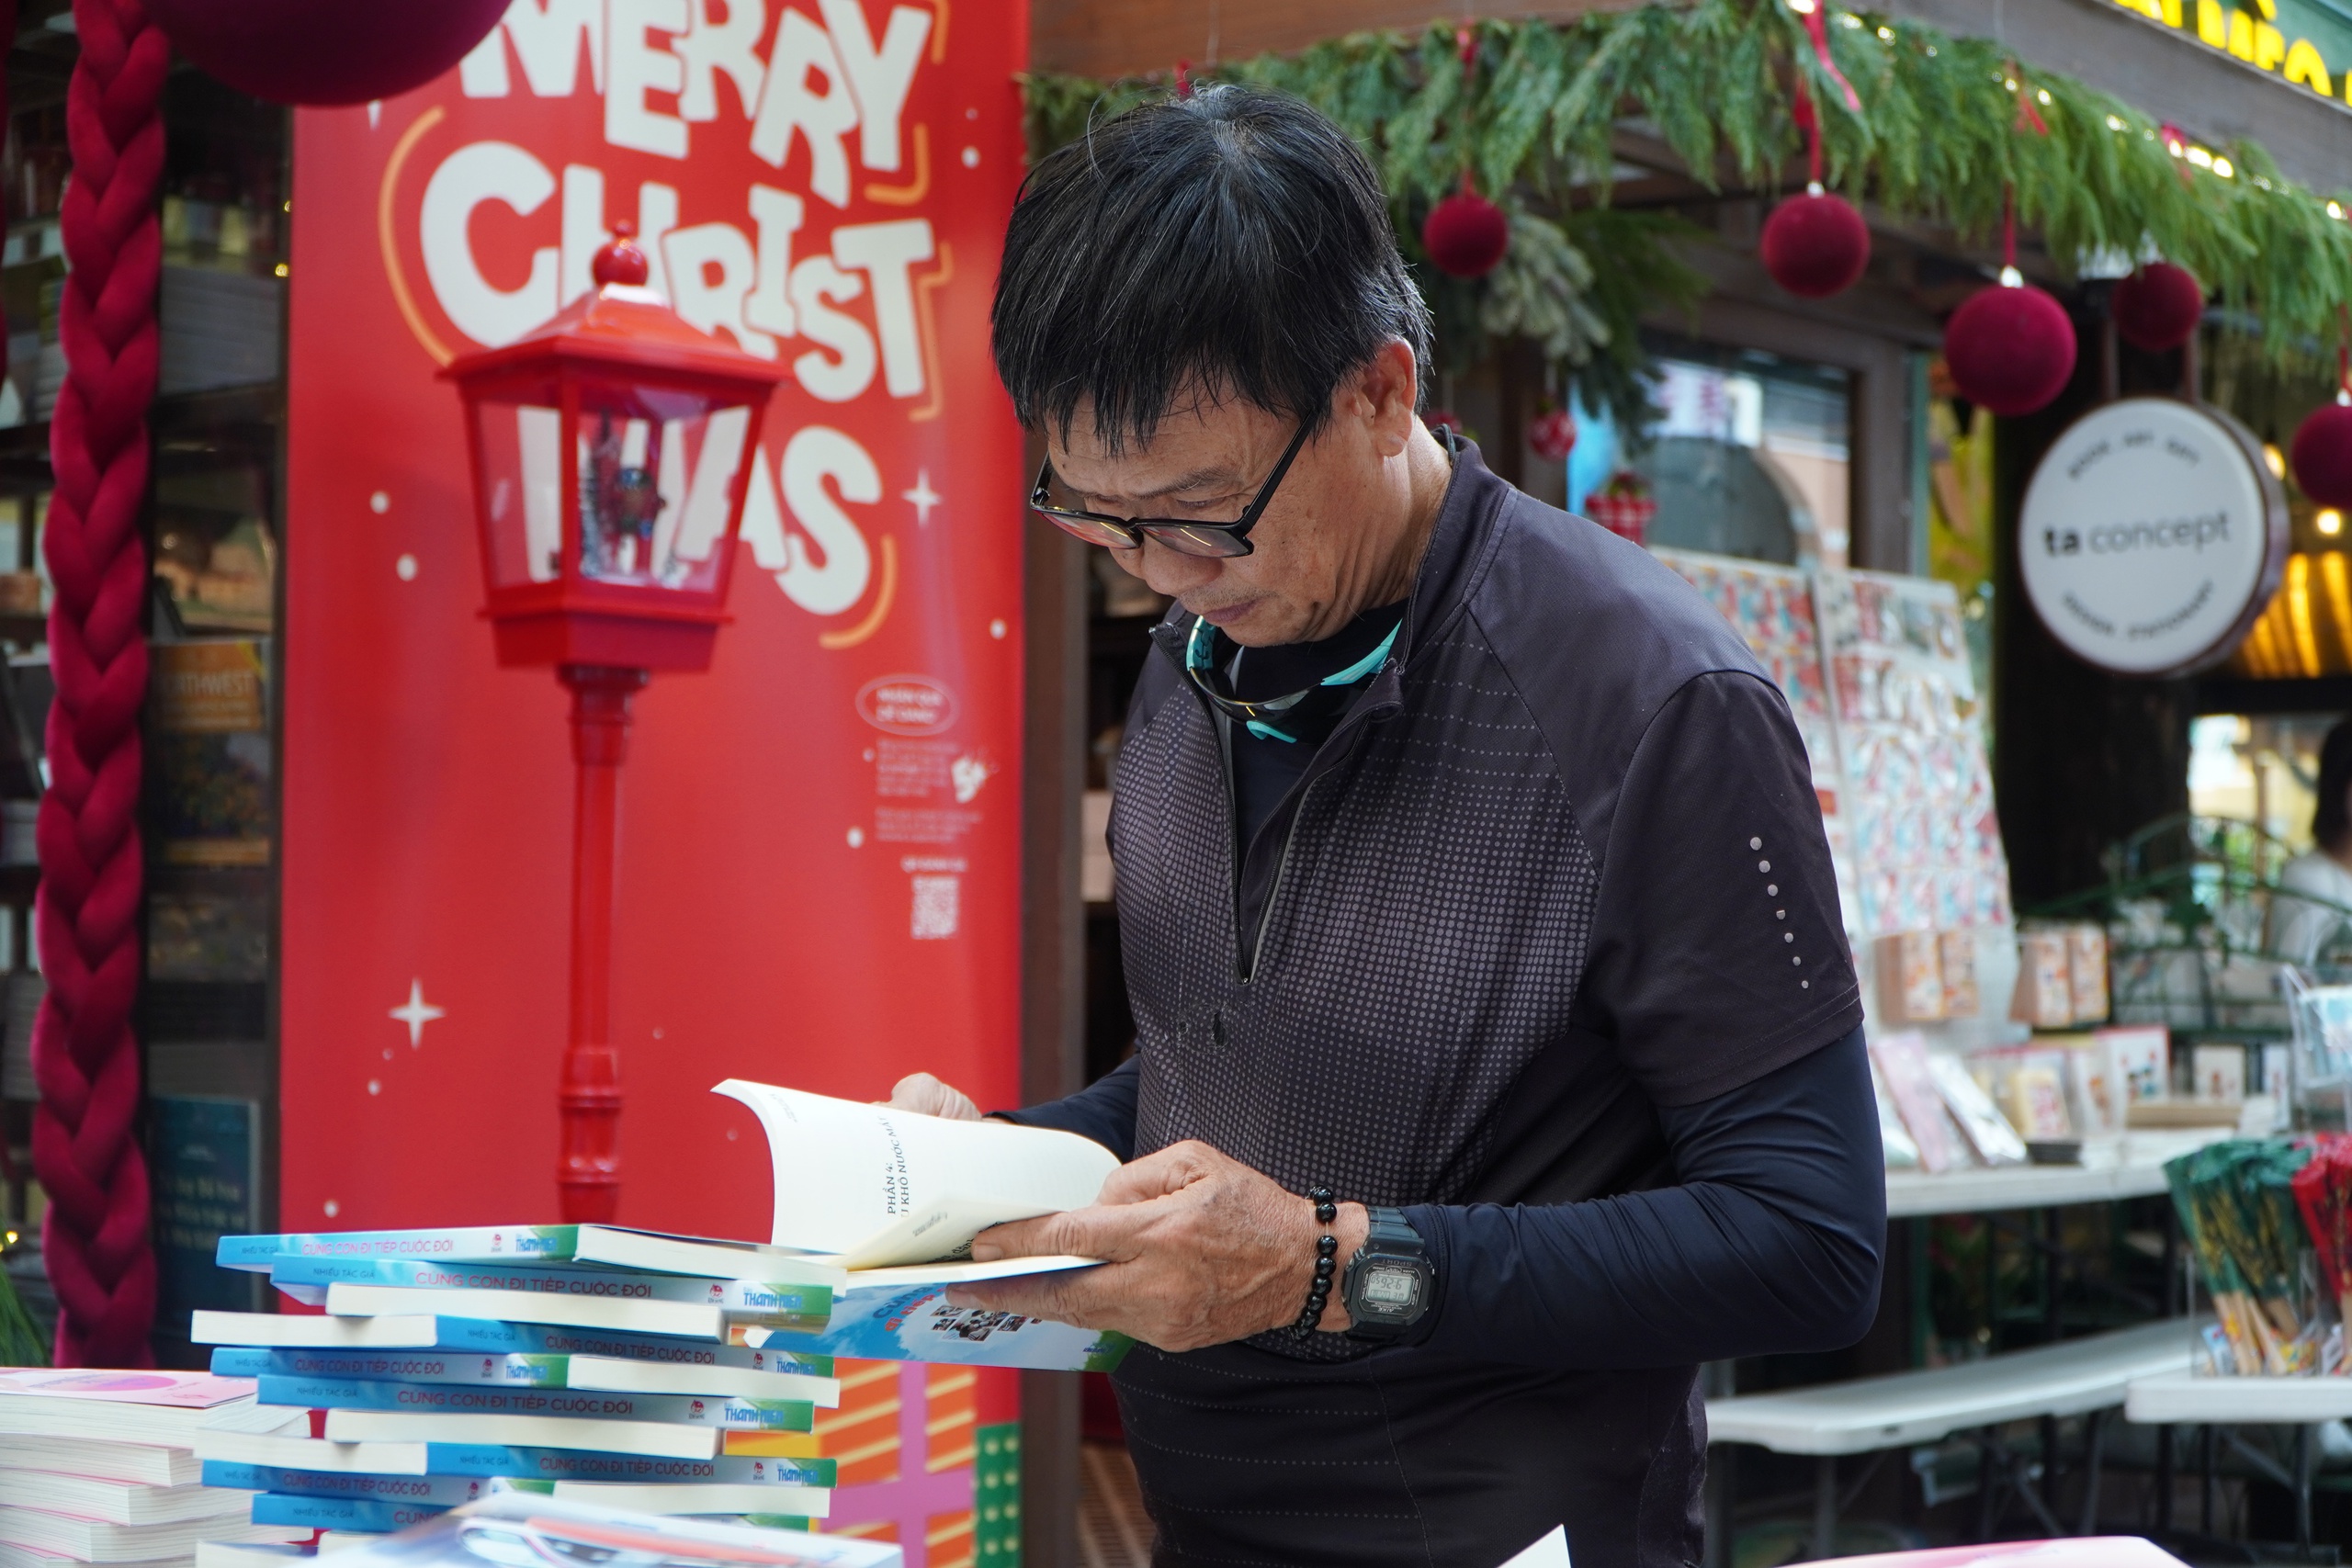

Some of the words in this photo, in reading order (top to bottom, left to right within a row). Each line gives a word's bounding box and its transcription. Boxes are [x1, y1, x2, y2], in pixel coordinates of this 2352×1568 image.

[420, 141, 934, 400] CHRIST
[2042, 525, 2081, 557] ta
[2087, 511, 2230, 553] concept
[890, 1139, 907, 1173] NƯỚC
[882, 1176, 897, 1215] PHẦN
[897, 1177, 909, 1205] KHÔ
[415, 1270, 464, 1286] CÙNG
[469, 1275, 504, 1290] CON
[508, 1277, 526, 1291] ĐI
[530, 1277, 566, 1292] TIẾP
[570, 1280, 618, 1296] CUỘC
[621, 1283, 652, 1298] ĐỜI
[546, 1336, 581, 1351] CÙNG
[584, 1340, 613, 1354] CON
[614, 1342, 626, 1355] ĐI
[630, 1342, 654, 1358] TIẾP
[658, 1347, 691, 1363] CUỘC
[695, 1349, 716, 1365] ĐỜI
[397, 1390, 446, 1405] CÙNG
[449, 1393, 487, 1407] CON
[490, 1395, 508, 1409] ĐI
[512, 1393, 548, 1409] TIẾP
[550, 1396, 599, 1413] CUỘC
[602, 1398, 634, 1415] ĐỜI
[539, 1455, 577, 1471] CÙNG
[580, 1458, 608, 1472] CON
[610, 1461, 624, 1473] ĐI
[627, 1459, 652, 1475] TIẾP
[654, 1461, 689, 1476] CUỘC
[692, 1461, 715, 1477] ĐỜI
